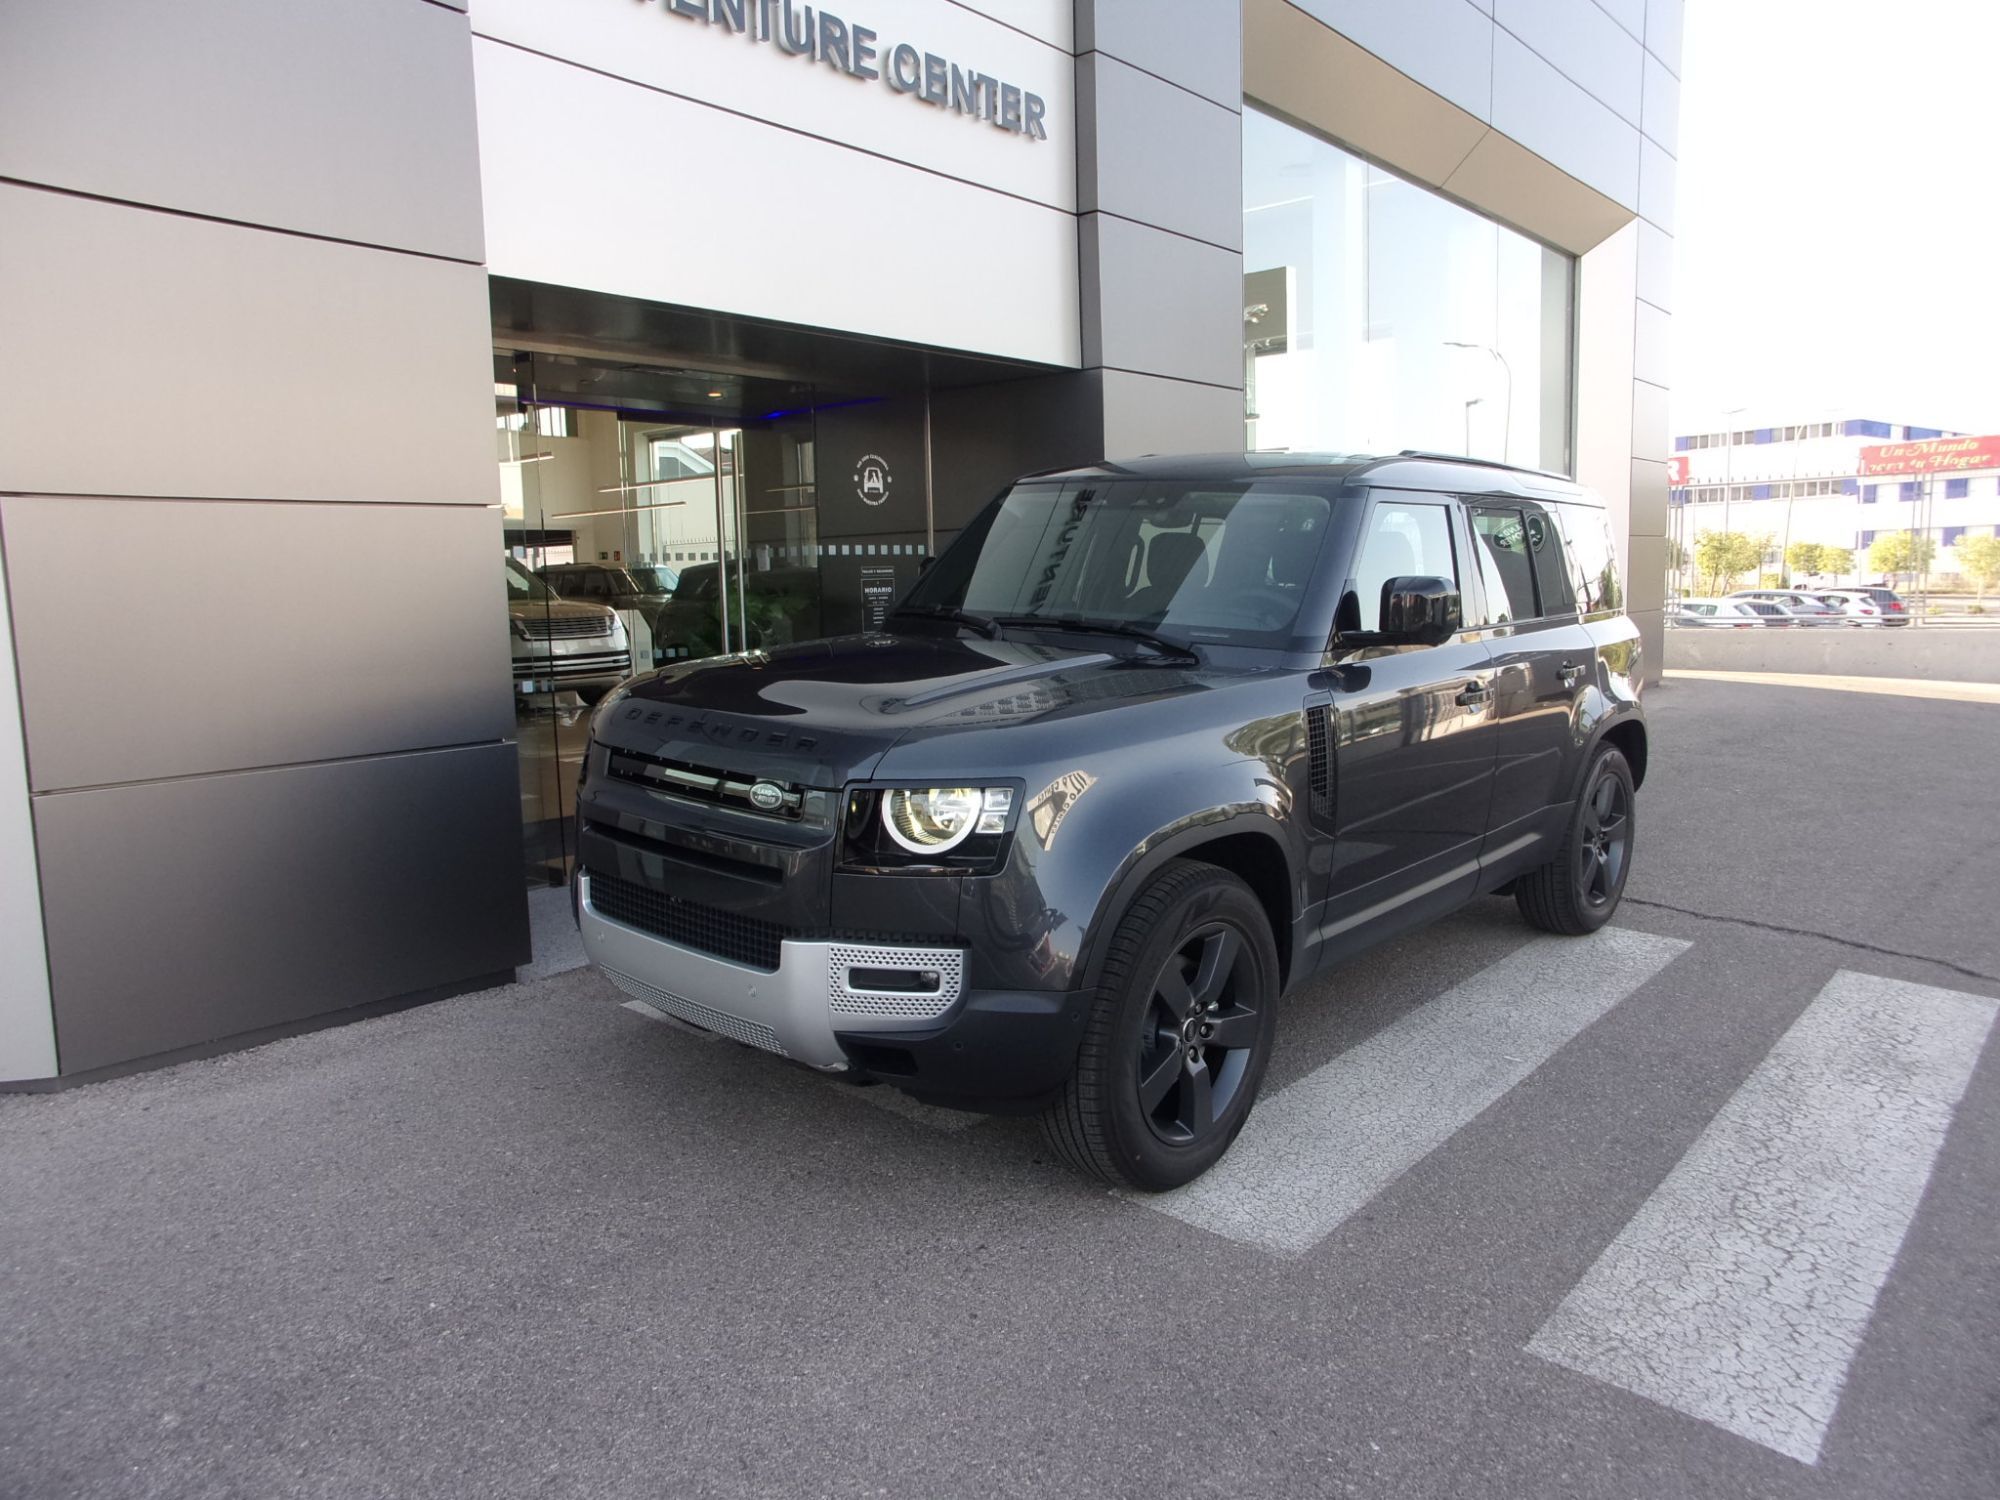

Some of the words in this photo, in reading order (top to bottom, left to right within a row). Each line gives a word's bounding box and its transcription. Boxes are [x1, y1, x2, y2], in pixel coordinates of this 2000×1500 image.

[888, 43, 1047, 140] CENTER
[1905, 440, 1979, 456] Mundo
[1929, 453, 1991, 469] Hogar
[864, 586, 893, 594] HORARIO
[625, 708, 818, 750] DEFENDER
